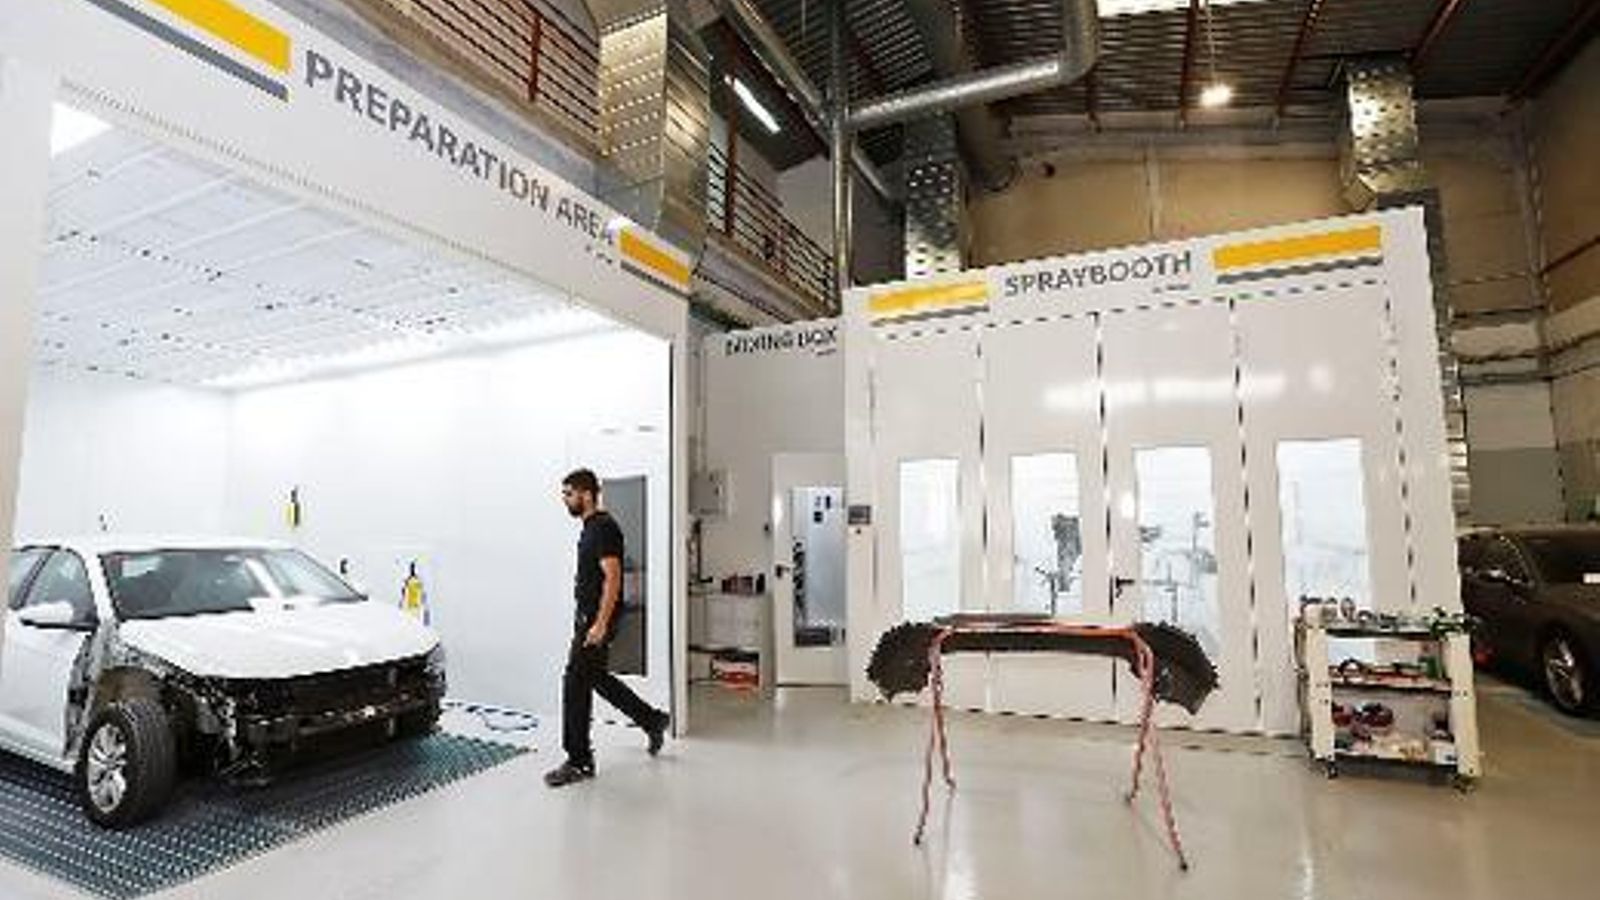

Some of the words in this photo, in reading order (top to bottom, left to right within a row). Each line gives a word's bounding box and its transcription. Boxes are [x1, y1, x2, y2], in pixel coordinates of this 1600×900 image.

[305, 49, 551, 212] PREPARATION
[556, 200, 614, 246] AREA
[1005, 250, 1191, 297] SPRAYBOOTH
